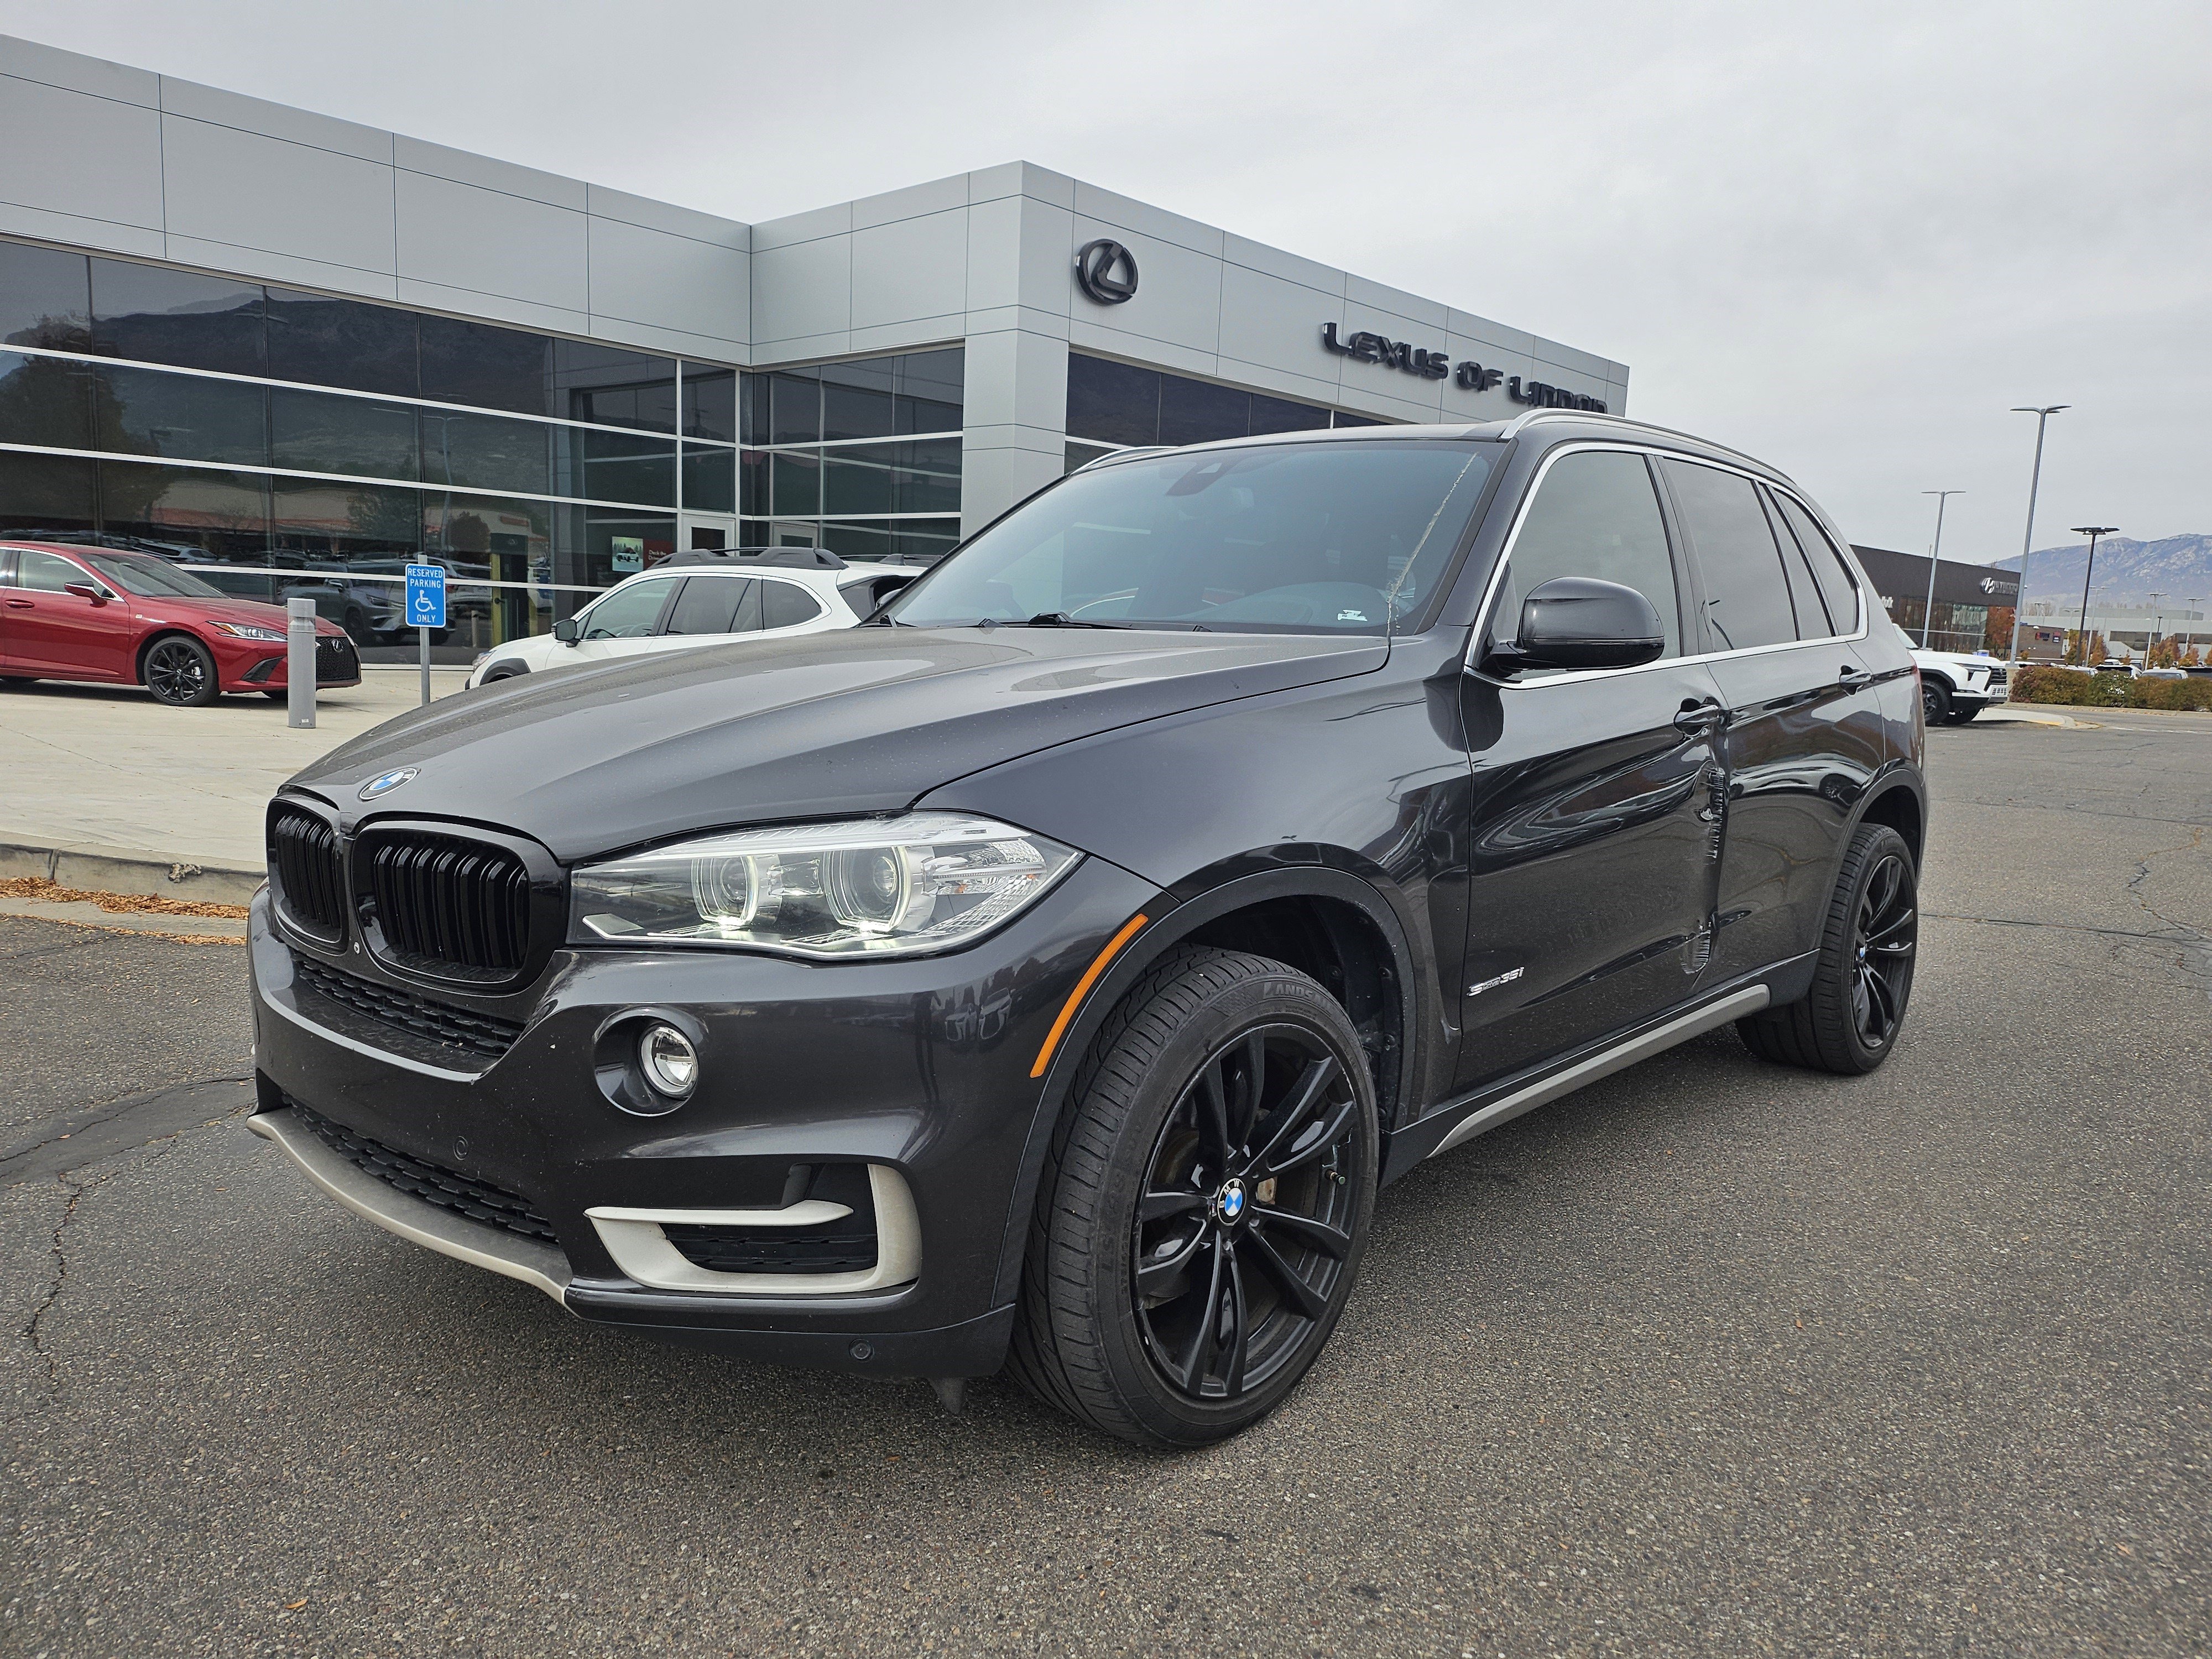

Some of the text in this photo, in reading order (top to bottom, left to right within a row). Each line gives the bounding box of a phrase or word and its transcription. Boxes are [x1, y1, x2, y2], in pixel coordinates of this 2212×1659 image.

[1323, 322, 1449, 379] LEXUS
[1457, 361, 1504, 392] OF
[408, 568, 442, 578] RESERVED
[410, 579, 441, 588] PARKING
[417, 614, 436, 623] ONLY
